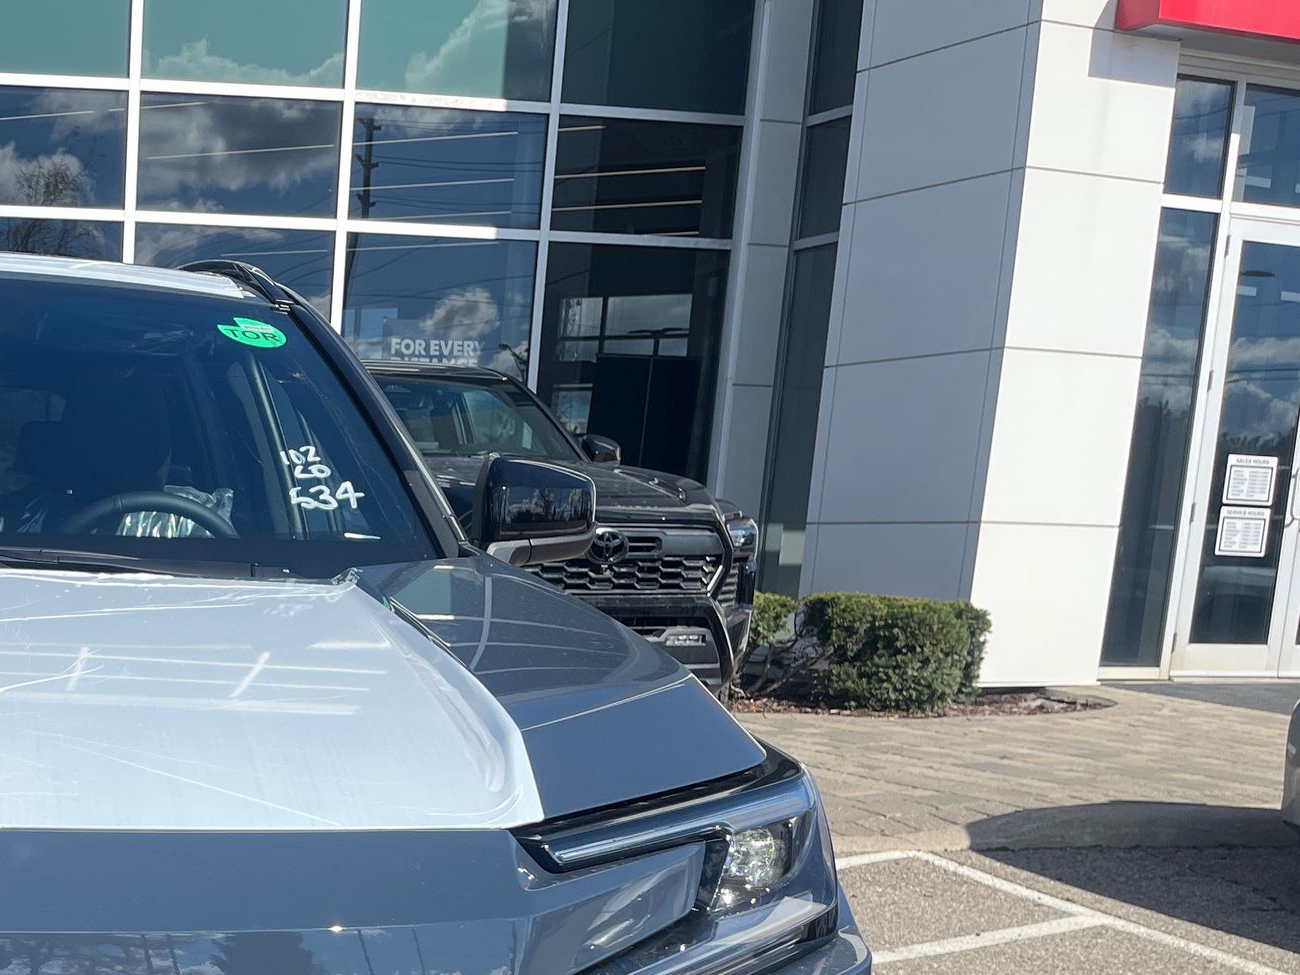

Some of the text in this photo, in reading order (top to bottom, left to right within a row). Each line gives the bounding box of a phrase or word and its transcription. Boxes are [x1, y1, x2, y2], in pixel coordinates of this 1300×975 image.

[223, 327, 282, 344] TOR
[391, 338, 484, 356] FOR EVERY
[289, 481, 365, 510] 534
